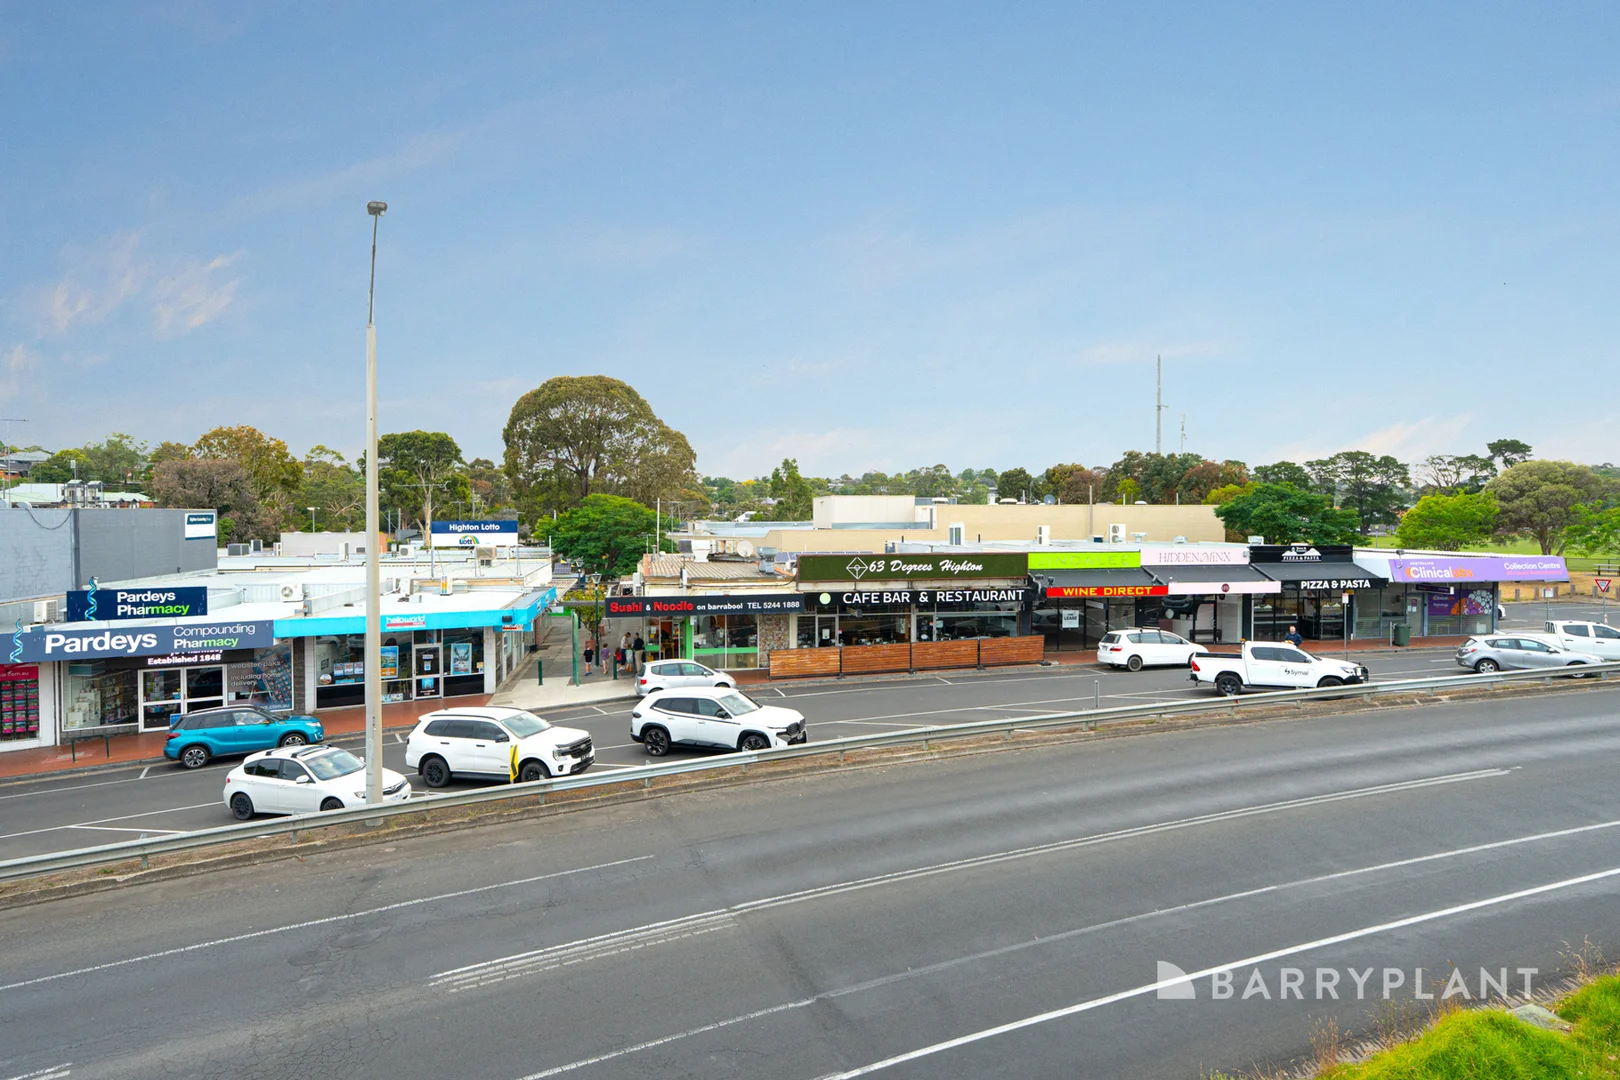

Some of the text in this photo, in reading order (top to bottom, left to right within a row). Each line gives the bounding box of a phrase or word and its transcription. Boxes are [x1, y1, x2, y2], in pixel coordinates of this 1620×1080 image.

[449, 524, 480, 532] Highton
[1159, 552, 1199, 563] HIDDEN
[869, 560, 983, 575] 63 Degrees Highton
[1504, 562, 1561, 570] Collection Centre
[1300, 580, 1371, 590] PIZZA & PASTA
[1062, 586, 1153, 596] WINE DIRECT
[117, 591, 176, 603] Pardeys
[842, 590, 1025, 604] CAFE BAR & RESTAURANT
[117, 604, 190, 616] Pharmacy
[610, 602, 643, 612] Sushi
[654, 601, 694, 611] Noodle
[173, 624, 256, 637] Compounding
[44, 631, 158, 654] Pardeys
[174, 638, 239, 650] Pharmacy
[148, 654, 222, 665] Established 1848
